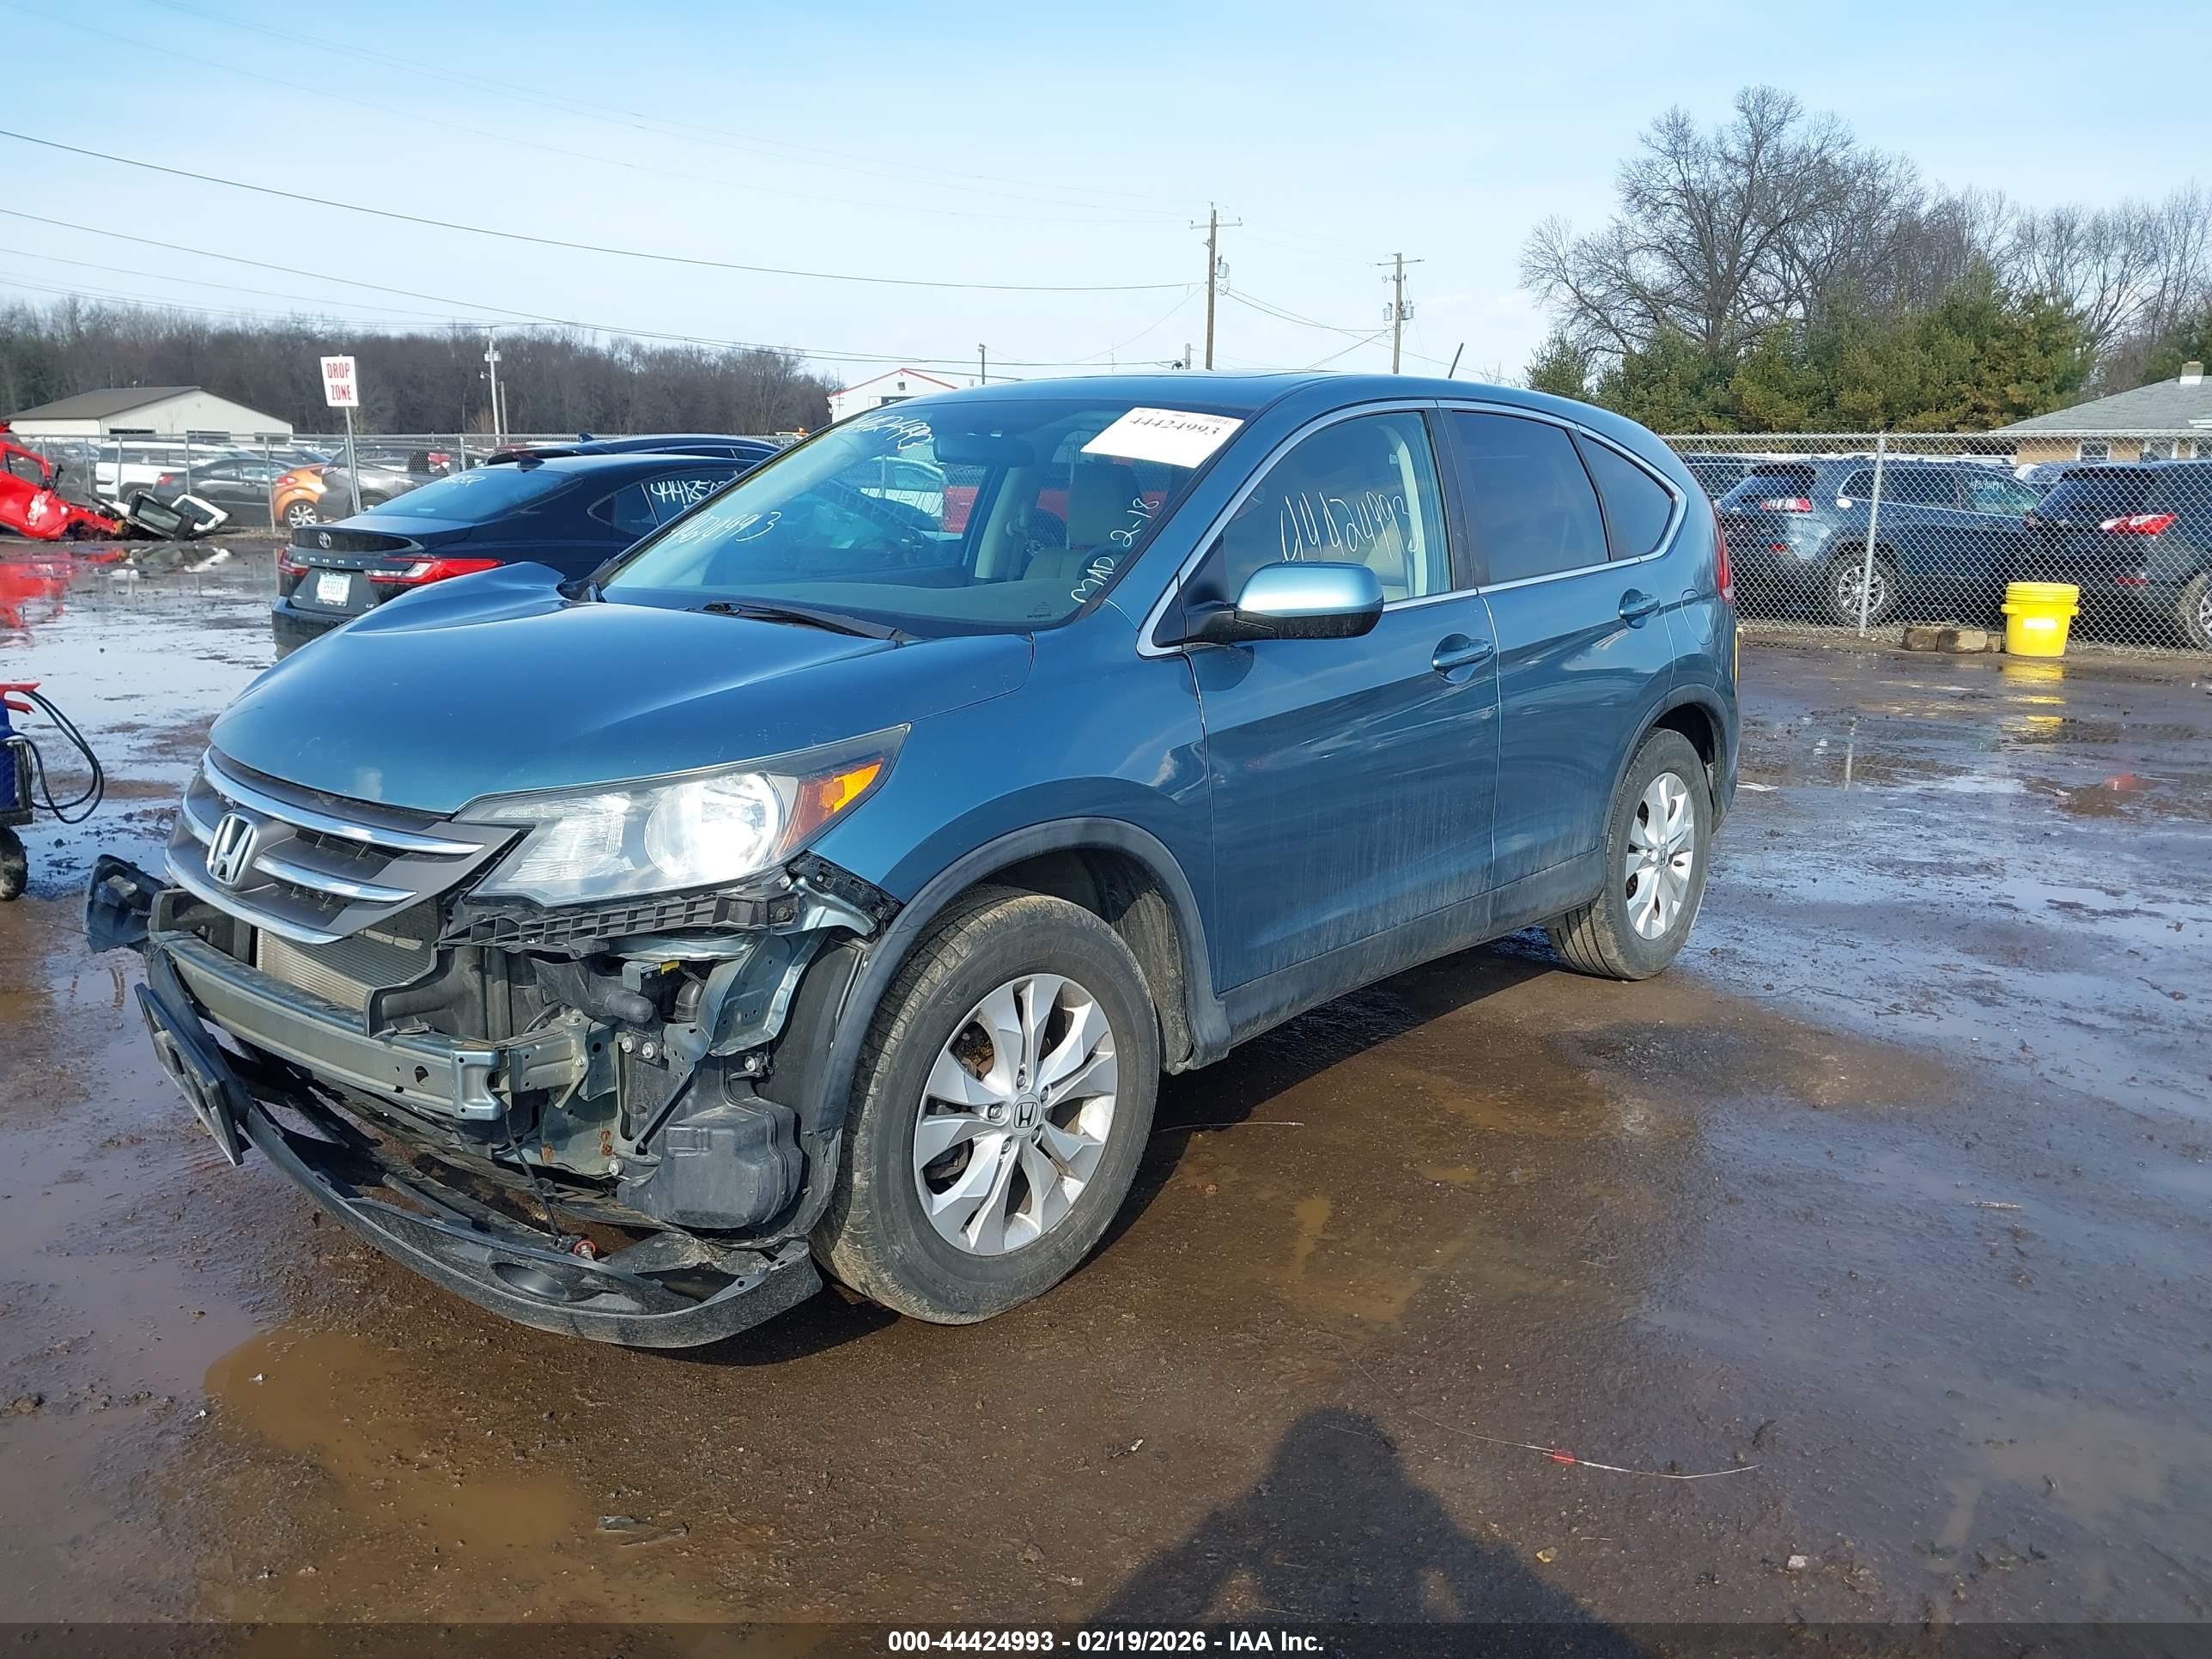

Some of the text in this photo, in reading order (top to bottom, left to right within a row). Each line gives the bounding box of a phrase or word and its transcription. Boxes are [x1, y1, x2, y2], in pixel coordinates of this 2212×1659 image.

[325, 362, 350, 379] DROP
[330, 384, 352, 401] ZONE
[1129, 416, 1220, 435] 44424993
[1109, 497, 1159, 548] 2-18
